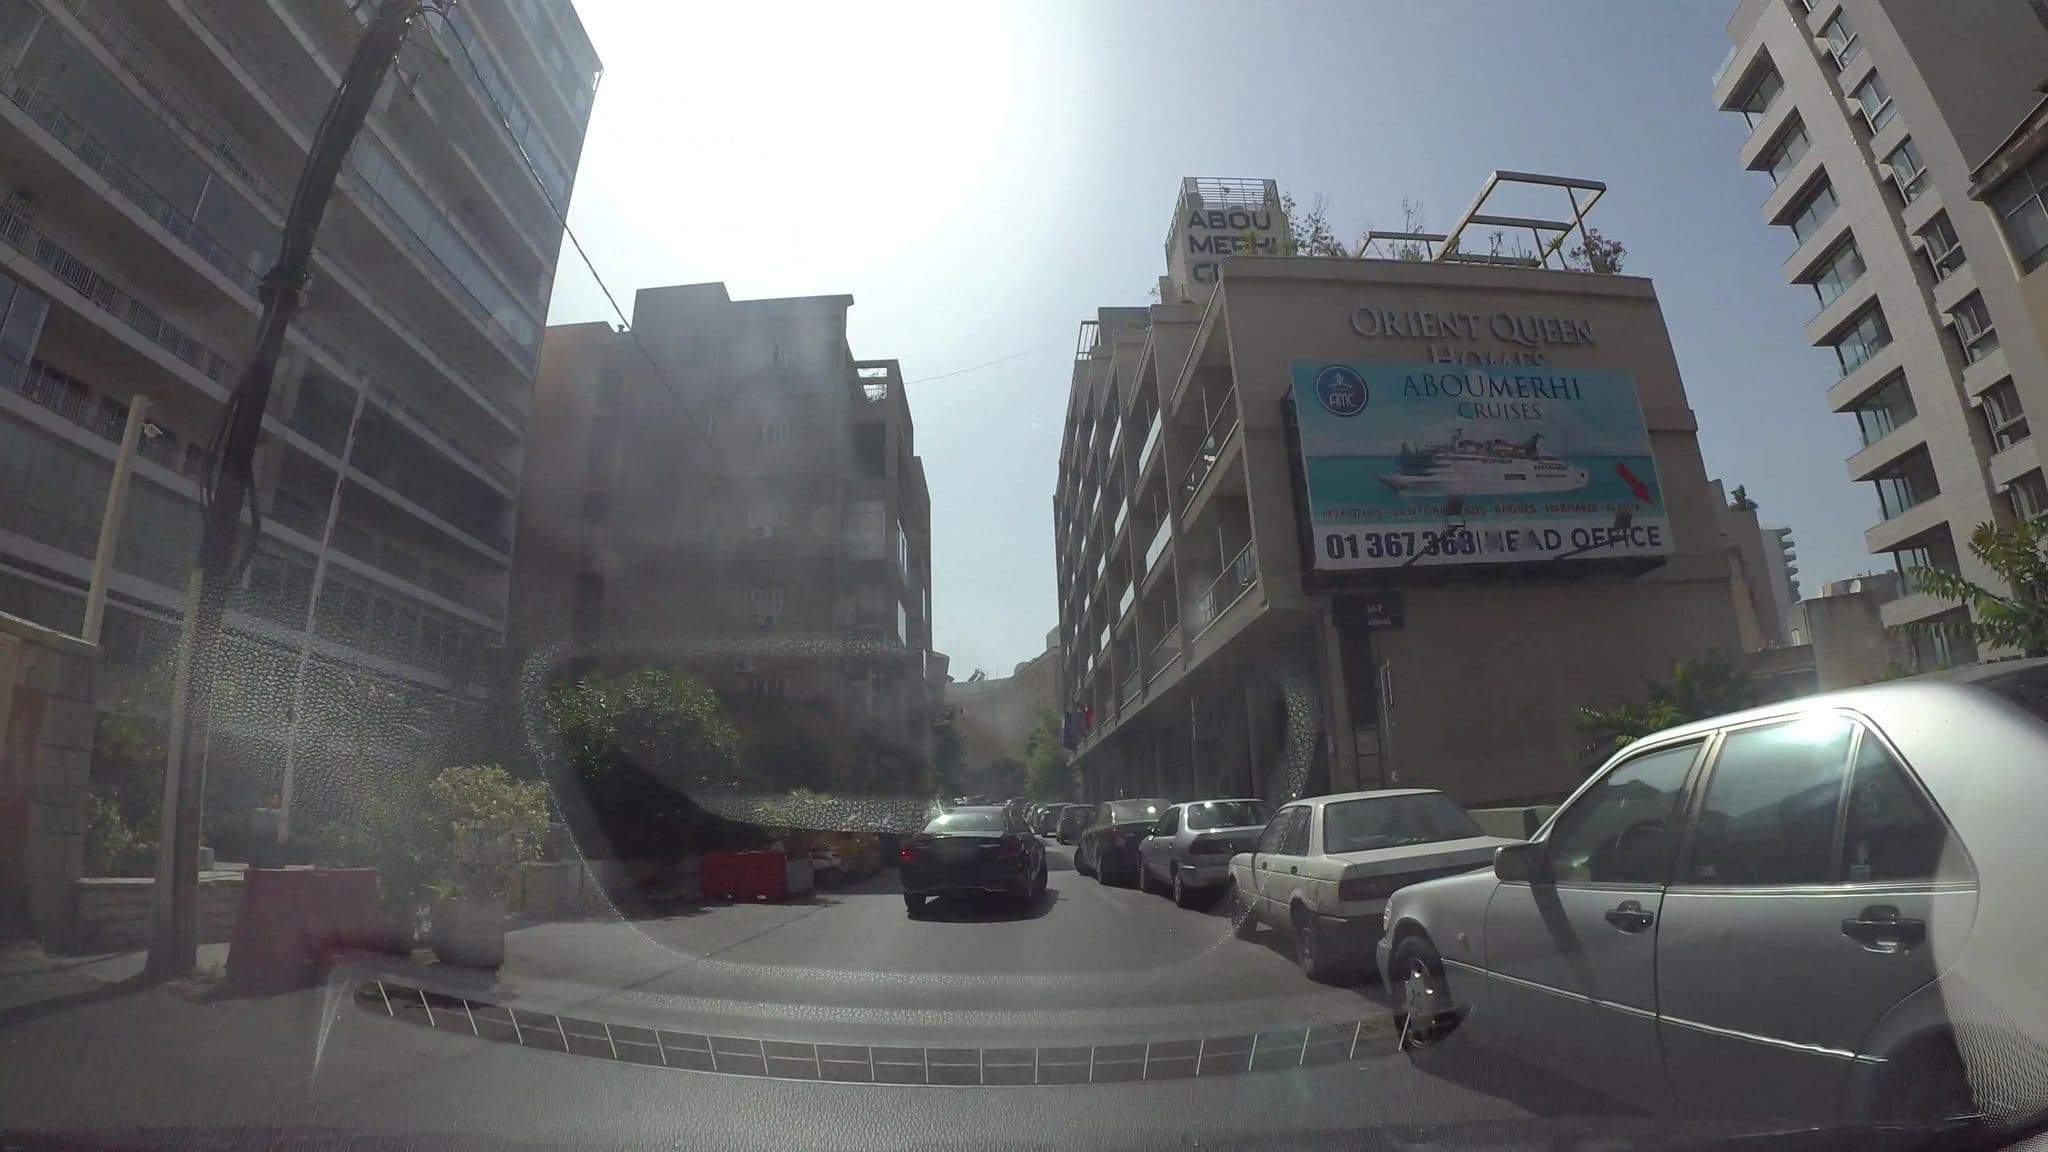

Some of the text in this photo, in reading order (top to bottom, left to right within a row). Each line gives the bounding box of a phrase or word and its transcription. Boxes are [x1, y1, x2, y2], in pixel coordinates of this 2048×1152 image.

[1188, 210, 1271, 230] ABOU
[1350, 304, 1595, 346] ORIENT QUEEN
[1402, 373, 1582, 400] ABOUMERHI
[1457, 402, 1542, 420] CRUISES
[1326, 533, 1359, 559] 01
[1365, 531, 1415, 558] 367
[1571, 524, 1663, 549] OFFICE
